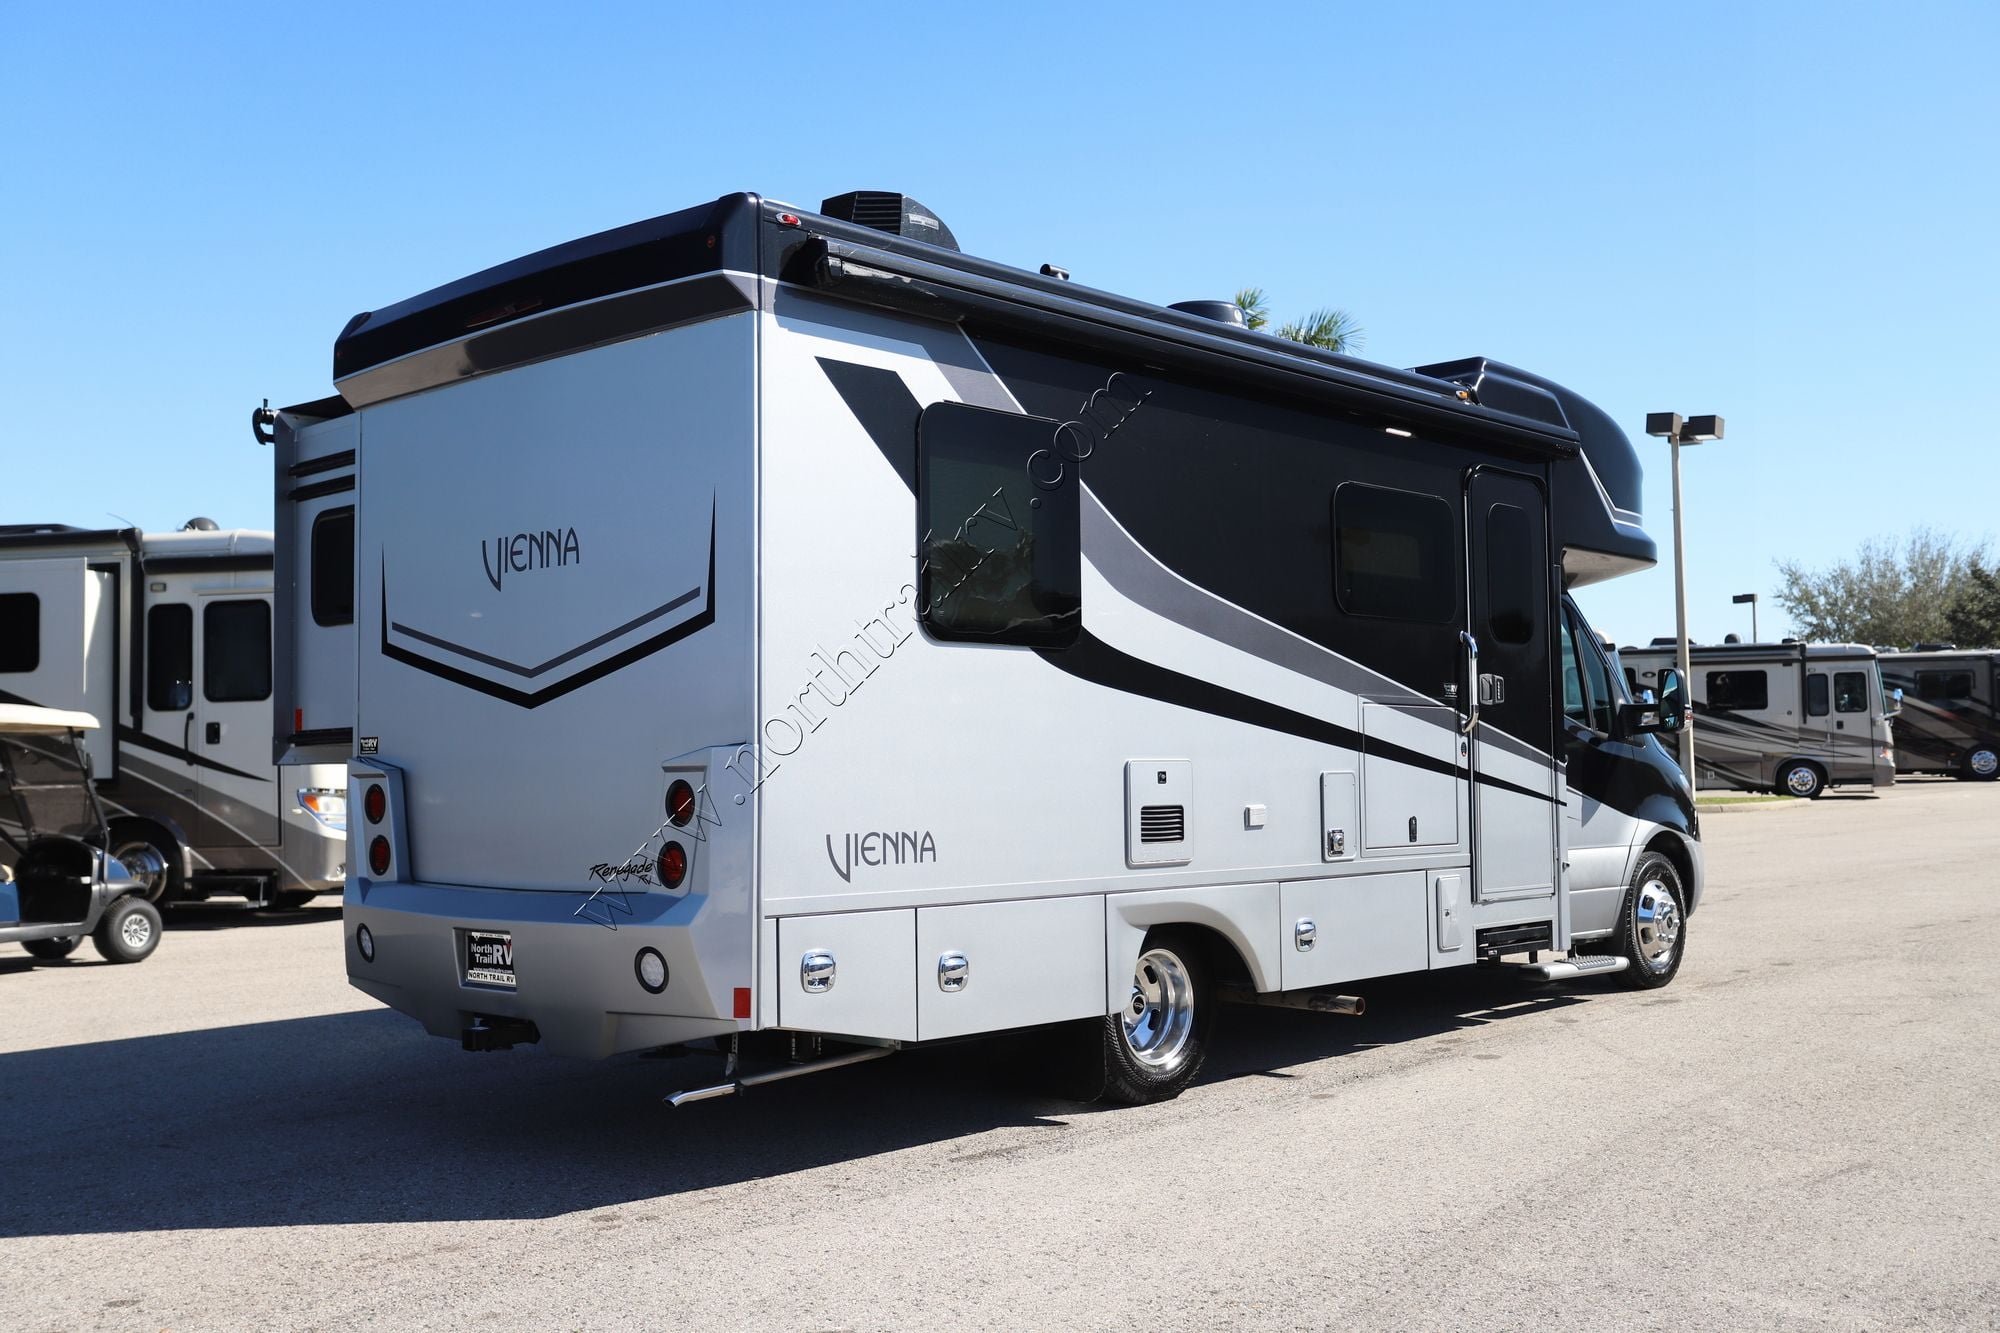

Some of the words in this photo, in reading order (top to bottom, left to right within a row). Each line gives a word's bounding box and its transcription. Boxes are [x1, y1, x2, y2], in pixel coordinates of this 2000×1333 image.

[482, 527, 580, 592] VIENNA
[826, 830, 937, 883] VIENNA
[589, 859, 653, 884] Renegade
[471, 944, 492, 953] North
[475, 954, 492, 964] Trail
[493, 944, 512, 965] RV
[469, 972, 487, 980] NORTH
[489, 974, 505, 982] TRAIL
